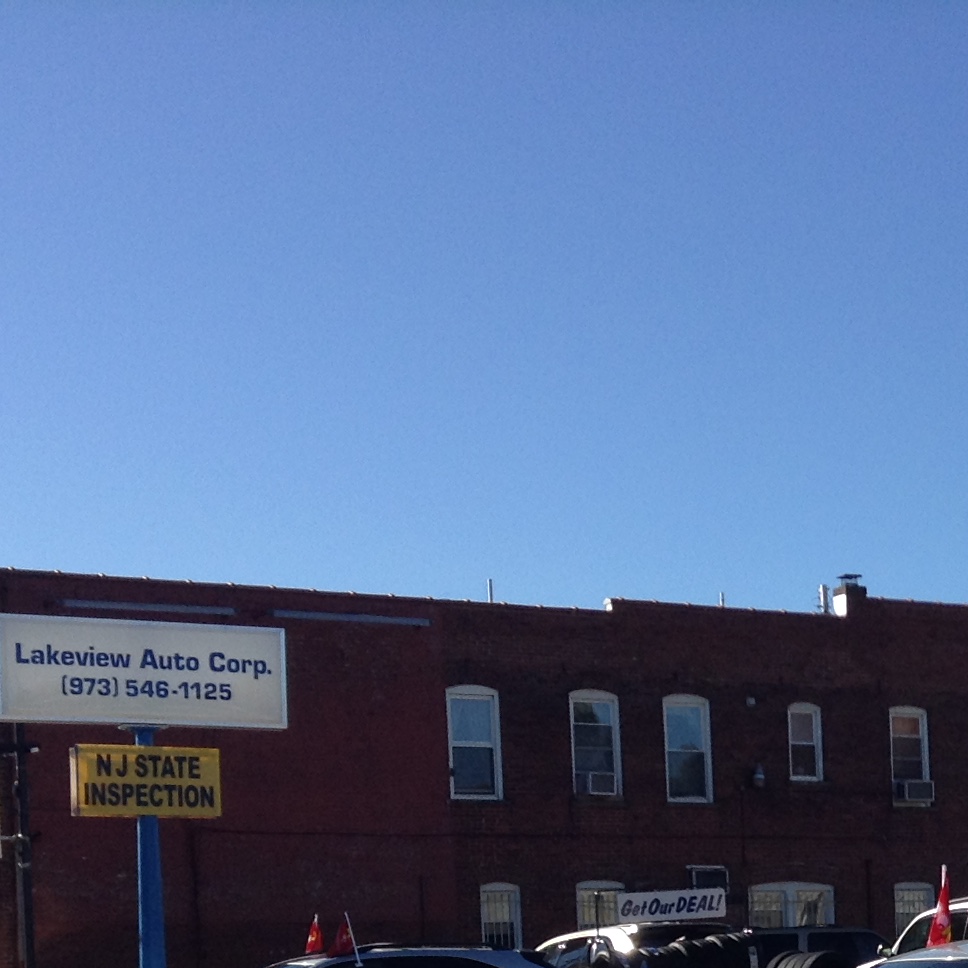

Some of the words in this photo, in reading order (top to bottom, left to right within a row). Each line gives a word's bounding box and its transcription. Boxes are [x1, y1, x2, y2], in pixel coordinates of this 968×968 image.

[15, 643, 130, 669] Lakeview
[140, 649, 199, 671] Auto
[209, 652, 272, 679] Corp.
[62, 675, 118, 697] (973)
[126, 680, 232, 701] 546-1125
[137, 755, 200, 779] STATE
[84, 782, 215, 808] INSPECTION
[621, 899, 647, 917] Get
[648, 898, 676, 916] Our
[676, 894, 722, 913] DEAL!
